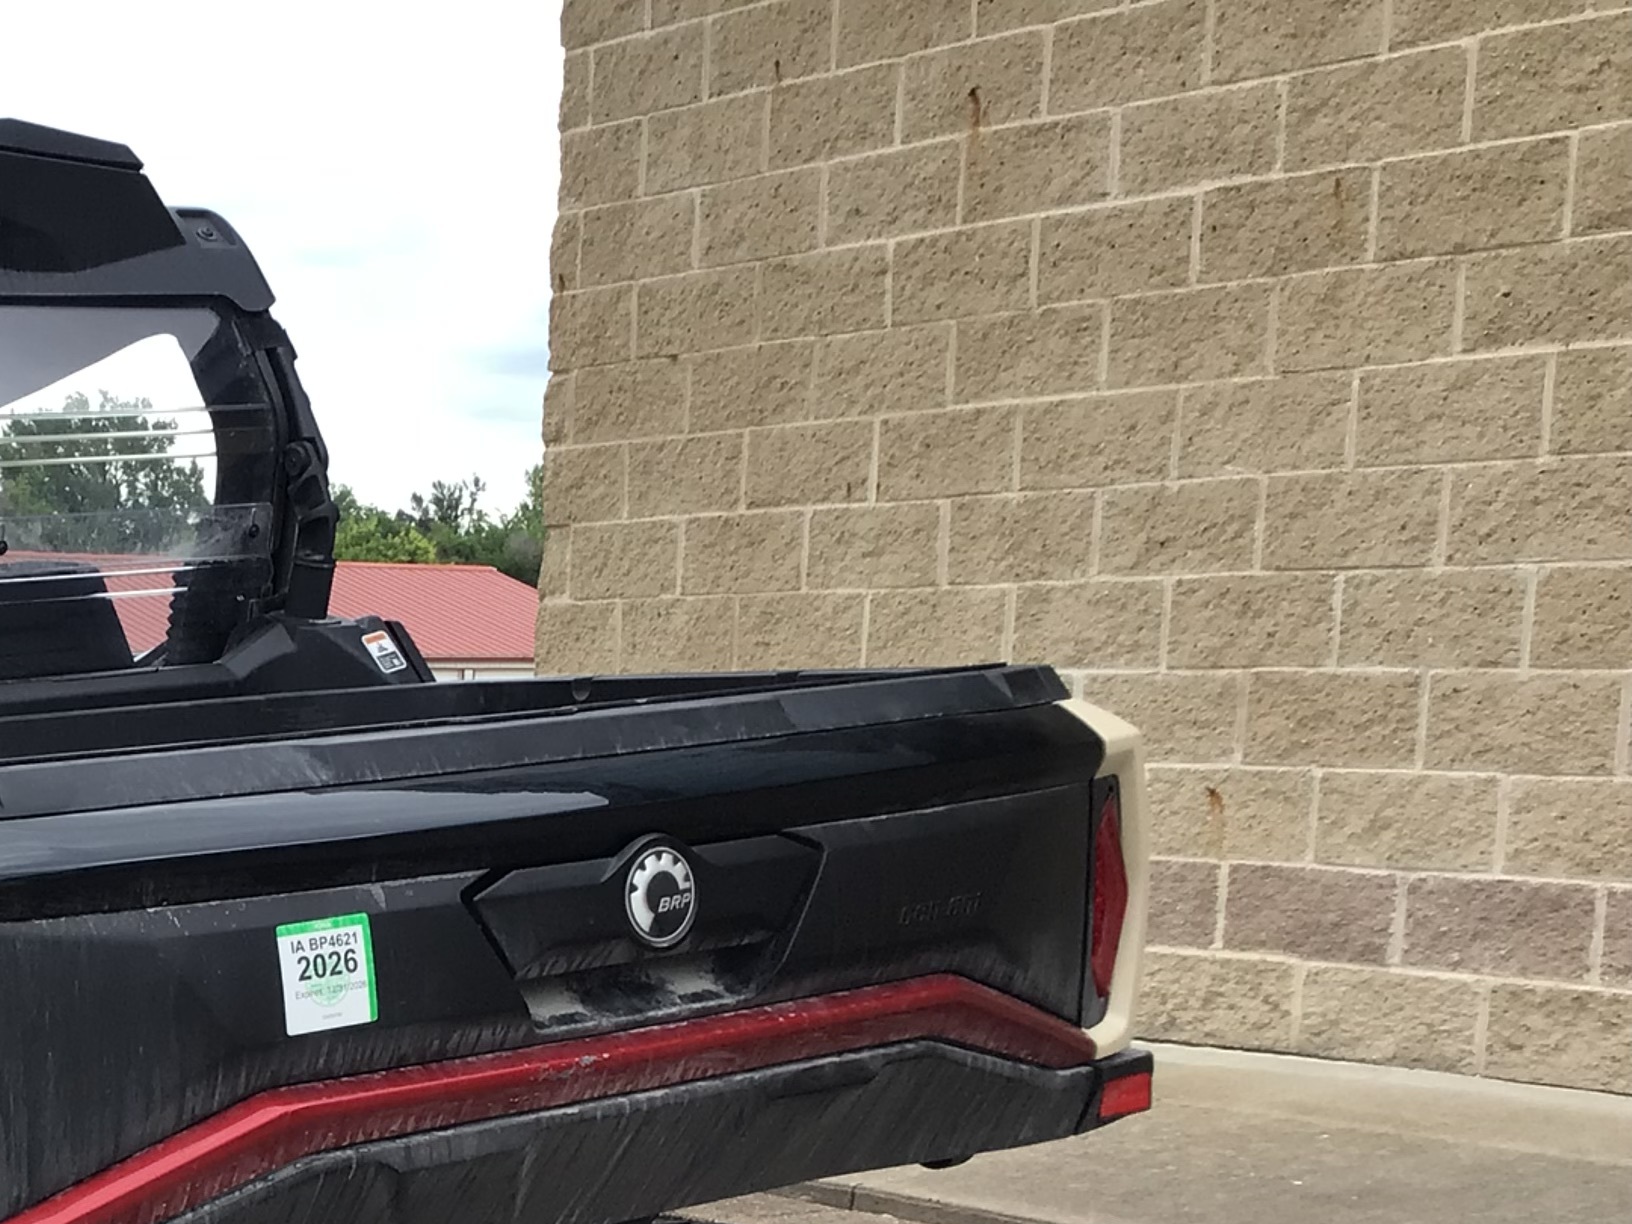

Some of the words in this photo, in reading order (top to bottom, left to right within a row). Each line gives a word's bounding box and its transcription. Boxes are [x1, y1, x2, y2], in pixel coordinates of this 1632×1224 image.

[658, 892, 692, 913] BRP
[290, 940, 306, 954] IA
[309, 931, 359, 951] BP4621
[297, 948, 358, 982] 2026
